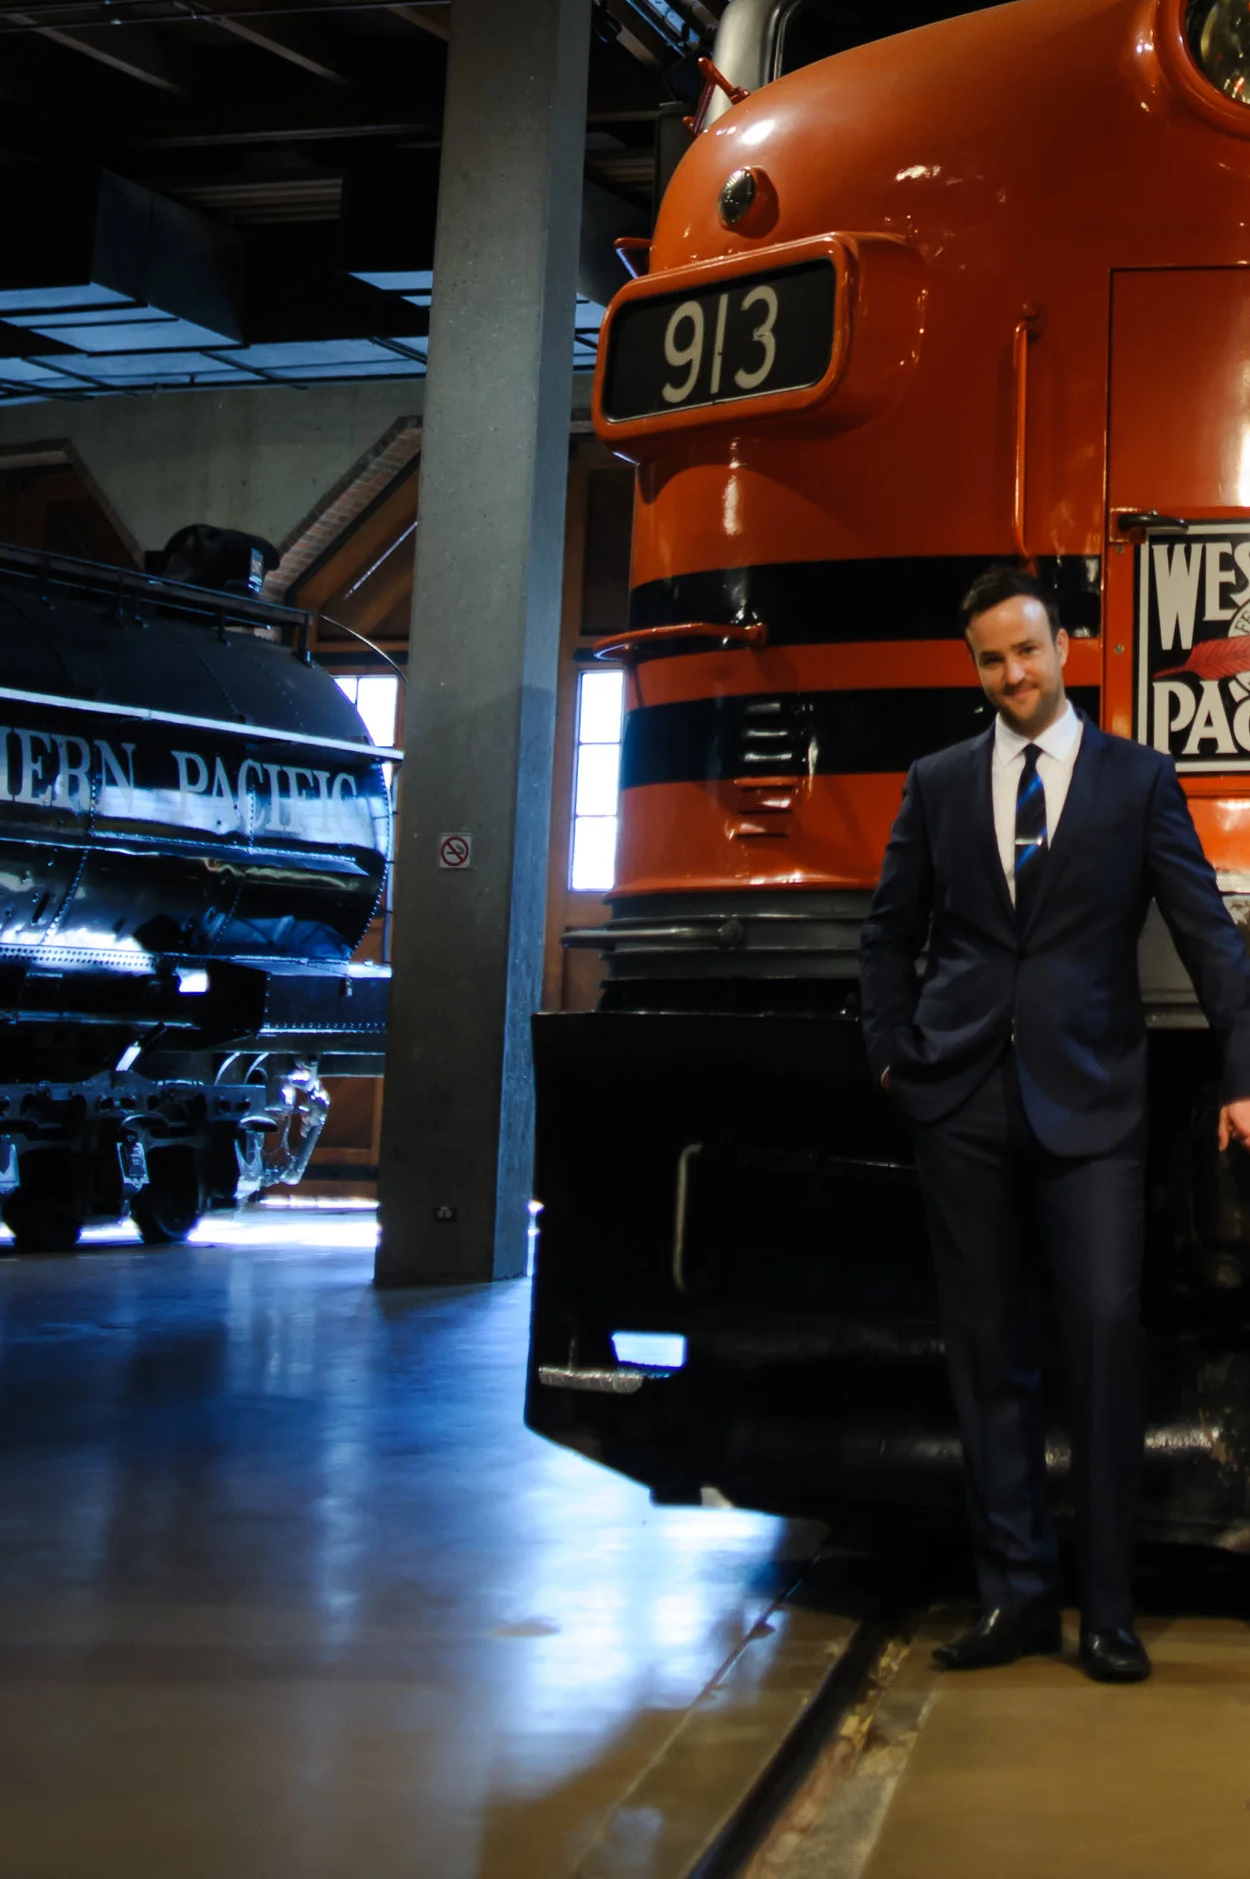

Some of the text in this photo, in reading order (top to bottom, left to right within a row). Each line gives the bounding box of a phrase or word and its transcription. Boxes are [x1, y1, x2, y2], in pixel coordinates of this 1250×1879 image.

[662, 285, 778, 403] 913
[0, 726, 358, 836] ERN PACIFIC
